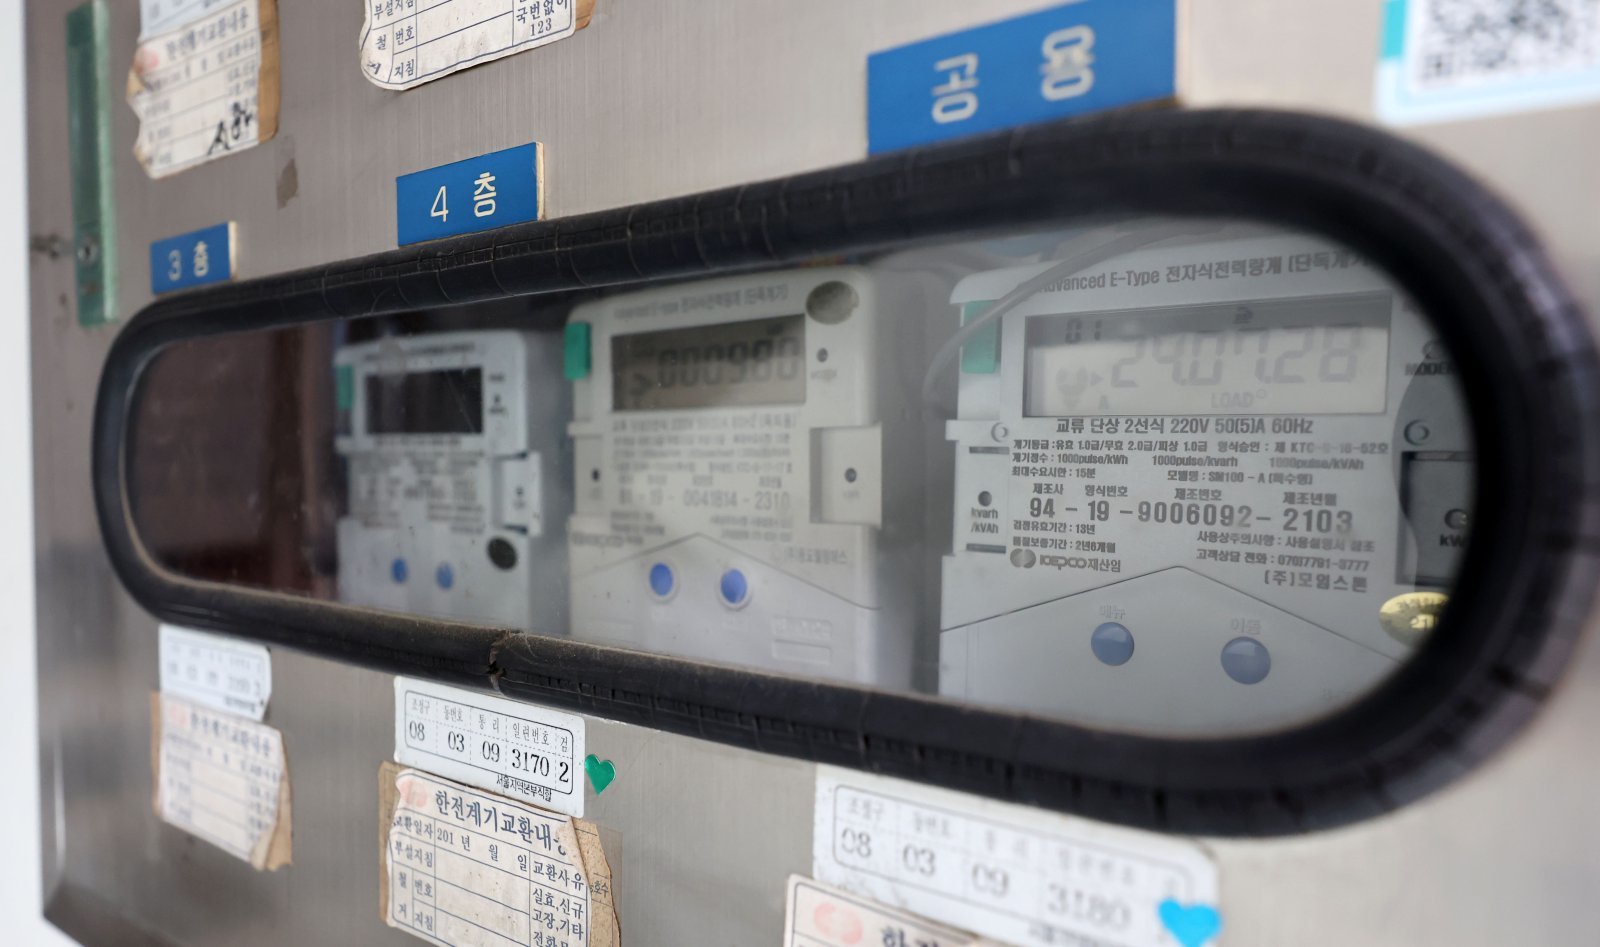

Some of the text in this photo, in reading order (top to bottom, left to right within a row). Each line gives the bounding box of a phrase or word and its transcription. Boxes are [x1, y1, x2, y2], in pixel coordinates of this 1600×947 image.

[395, 25, 415, 46] 번호
[530, 18, 553, 37] 123
[394, 58, 415, 79] 지침
[430, 172, 497, 222] 4 층
[167, 248, 183, 282] 3
[1109, 270, 1160, 294] E-Type
[1057, 418, 1084, 434] 교류
[1090, 418, 1119, 434] 단상
[1124, 418, 1164, 434] 2선식
[1170, 418, 1209, 434] 220V
[1272, 418, 1313, 434] 60Hz
[1033, 484, 1063, 495] 제조사
[1085, 484, 1128, 499] 형식번호
[1175, 488, 1222, 504] 제조번호
[971, 507, 999, 520] kvarh
[1030, 498, 1055, 519] 94
[1088, 501, 1110, 522] 19
[1138, 501, 1252, 529] 9006092
[1076, 523, 1096, 536] 13년
[409, 720, 569, 783] 08 03 09 3170 2
[394, 840, 433, 868] 부설지침
[437, 828, 454, 845] 201
[461, 836, 471, 852] 년
[489, 845, 499, 863] 월
[518, 855, 527, 871] 일
[534, 862, 584, 892] 교환사유
[841, 828, 871, 858] 08
[903, 844, 935, 877] 03
[972, 862, 1009, 898] 09
[533, 888, 584, 919] 실효,신규
[415, 912, 433, 931] 지침
[532, 907, 584, 940] 고장,기타
